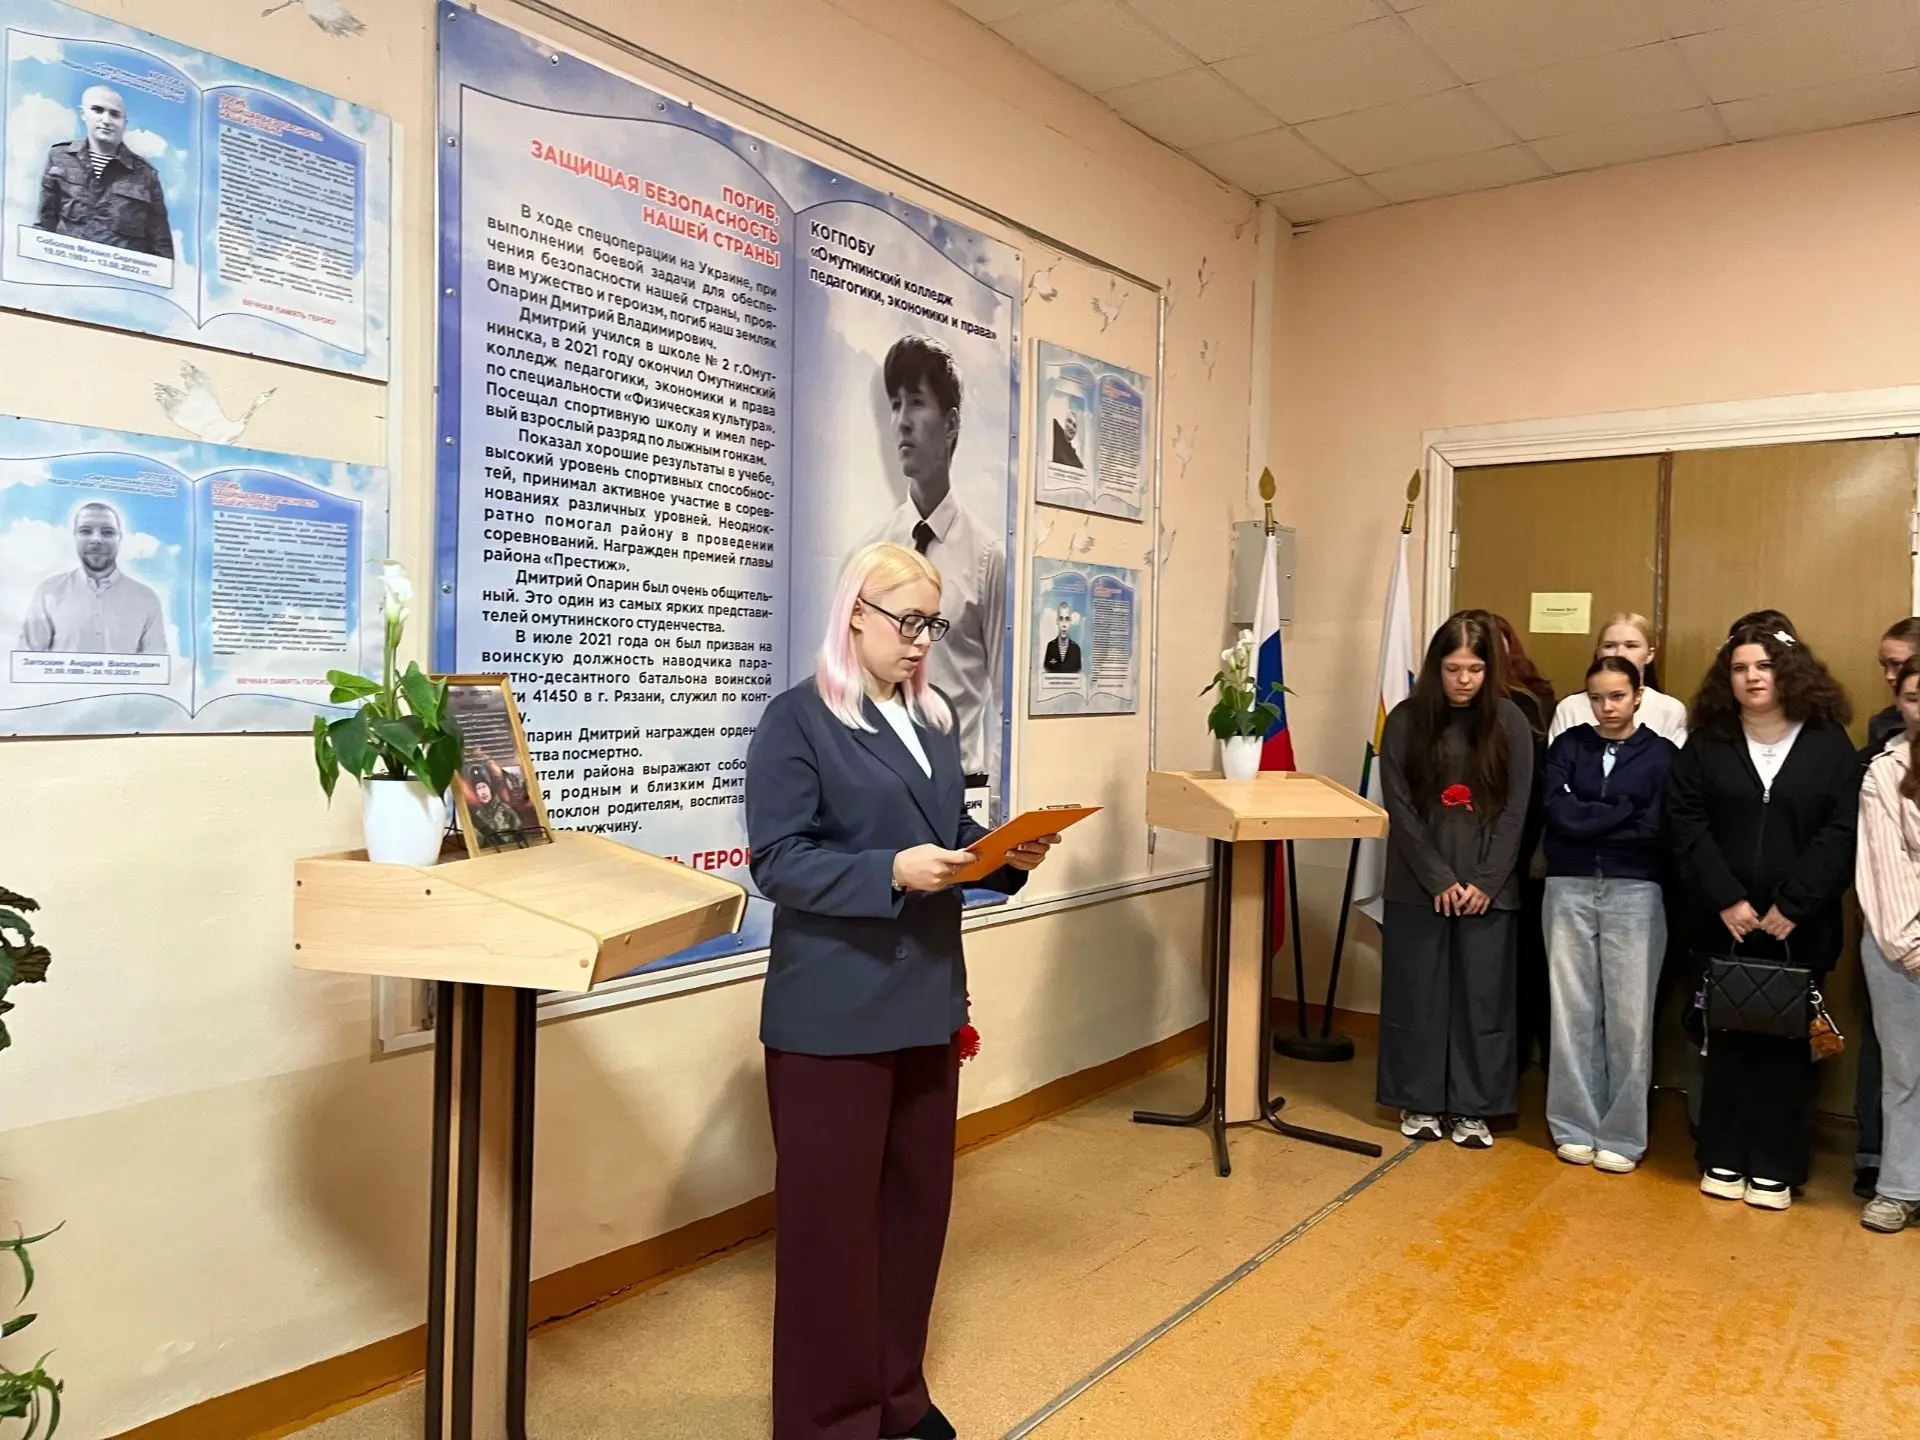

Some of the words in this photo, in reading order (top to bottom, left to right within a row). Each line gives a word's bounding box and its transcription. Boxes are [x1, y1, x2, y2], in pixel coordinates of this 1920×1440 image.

[530, 140, 640, 192] ЗАЩИЩАЯ
[644, 182, 778, 244] БЕЗОПАСНОСТЬ
[722, 186, 778, 224] ПОГИБ,
[521, 203, 531, 218] В
[536, 211, 572, 232] ходе
[577, 225, 676, 264] спецоперации
[680, 257, 694, 270] на
[698, 261, 753, 291] Украине,
[756, 282, 777, 297] при
[642, 206, 708, 242] НАШЕЙ
[712, 234, 780, 268] СТРАНЫ
[810, 220, 876, 256] КОГПОБУ
[487, 216, 583, 255] выполнении
[592, 247, 643, 273] боевой
[651, 267, 695, 289] задачи
[702, 283, 724, 298] для
[731, 292, 776, 312] обеспе-
[487, 237, 534, 261] чения
[541, 251, 640, 292] безопасности
[645, 284, 688, 305] нашей
[692, 298, 740, 322] страны,
[744, 313, 776, 330] проя-
[810, 246, 902, 288] «Омутнинский
[904, 280, 954, 306] колледж
[487, 259, 515, 276] вив
[519, 267, 593, 297] мужество
[596, 289, 604, 301] и
[607, 292, 667, 320] героизм,
[670, 310, 706, 328] погиб
[708, 321, 733, 336] наш
[735, 328, 776, 348] земляк
[487, 277, 547, 305] Опарин
[549, 294, 614, 322] Дмитрий
[617, 311, 716, 349] Владимирович.
[810, 268, 884, 306] педагогики,
[886, 296, 950, 324] экономики
[950, 316, 958, 326] и
[960, 318, 998, 340] права»
[486, 321, 546, 348] нинска,
[551, 336, 560, 348] в
[564, 337, 597, 357] 2021
[602, 349, 634, 367] году
[638, 358, 693, 380] окончил
[697, 369, 776, 399] Омутнинский
[518, 306, 586, 335] Дмитрий
[592, 327, 640, 348] учился
[646, 340, 653, 351] в
[658, 344, 700, 363] школе
[705, 353, 717, 366] №
[722, 358, 729, 370] 2
[486, 342, 557, 367] колледж
[564, 359, 648, 390] педагогики,
[654, 380, 724, 404] экономики
[729, 397, 736, 407] и
[742, 400, 775, 416] права
[486, 363, 506, 376] по
[509, 368, 621, 400] специальности
[624, 392, 710, 419] «Физическая
[712, 411, 775, 434] культура».
[485, 404, 517, 420] вый
[520, 410, 594, 434] взрослый
[596, 425, 646, 445] разряд
[648, 434, 664, 446] по
[665, 438, 720, 457] лыжным
[722, 449, 767, 466] гонкам.
[486, 380, 557, 407] Посещал
[564, 399, 650, 425] спортивную
[655, 417, 698, 436] школу
[703, 427, 710, 437] и
[715, 430, 745, 444] имел
[749, 436, 775, 451] пер-
[485, 446, 553, 466] высокий
[559, 457, 620, 476] уровень
[624, 468, 703, 489] спортивных
[707, 481, 774, 500] способнос-
[518, 428, 581, 451] Показал
[585, 442, 648, 462] хорошие
[652, 454, 724, 475] результаты
[728, 467, 735, 477] в
[737, 469, 774, 486] учебе,
[484, 465, 516, 484] тей,
[522, 472, 596, 492] принимал
[602, 483, 665, 502] активное
[670, 493, 719, 510] участие
[724, 502, 731, 511] в
[735, 504, 774, 517] сорев-
[484, 487, 559, 507] нованиях
[568, 498, 645, 518] различных
[654, 509, 711, 526] уровней.
[718, 516, 774, 534] Неоднок-
[483, 528, 598, 550] соревнований.
[603, 538, 678, 558] Награжден
[683, 549, 735, 564] премией
[739, 556, 773, 568] главы
[484, 507, 534, 523] ратно
[545, 514, 611, 532] помогал
[620, 523, 673, 542] району
[681, 531, 688, 541] в
[696, 533, 773, 551] проведении
[483, 547, 540, 564] района
[543, 552, 629, 572] «Престиж».
[482, 588, 519, 602] ный.
[524, 589, 552, 604] Это
[557, 594, 594, 608] один
[598, 597, 614, 608] из
[619, 599, 662, 611] самых
[666, 602, 703, 614] ярких
[707, 605, 773, 618] представи-
[515, 569, 582, 588] Дмитрий
[586, 574, 639, 592] Опарин
[642, 579, 668, 593] был
[671, 584, 708, 596] очень
[710, 586, 773, 601] общитель-
[481, 608, 528, 623] телей
[531, 612, 634, 628] омутнинского
[636, 618, 725, 632] студенчества.
[515, 629, 526, 643] В
[532, 632, 572, 644] июле
[578, 632, 611, 645] 2021
[617, 636, 648, 648] года
[654, 637, 670, 648] он
[675, 636, 701, 649] был
[706, 640, 754, 652] призван
[758, 642, 772, 652] на
[481, 651, 563, 666] воинскую
[572, 653, 654, 666] должность
[662, 656, 732, 668] наводчика
[738, 658, 772, 670] пара-
[638, 671, 707, 684] батальона
[714, 672, 772, 685] воинской
[532, 689, 578, 702] 41450
[583, 692, 592, 702] в
[598, 692, 608, 702] г.
[614, 689, 664, 704] Рязани,
[669, 692, 717, 704] служил
[721, 692, 737, 702] по
[740, 692, 772, 702] конт-
[526, 730, 572, 745] парин
[578, 726, 640, 743] Дмитрий
[645, 727, 715, 741] награжден
[562, 747, 643, 762] посмертно.
[560, 784, 621, 801] родным
[630, 784, 638, 794] и
[647, 777, 704, 793] близким
[583, 765, 634, 781] района
[642, 761, 711, 777] выражают
[607, 798, 683, 817] родителям,
